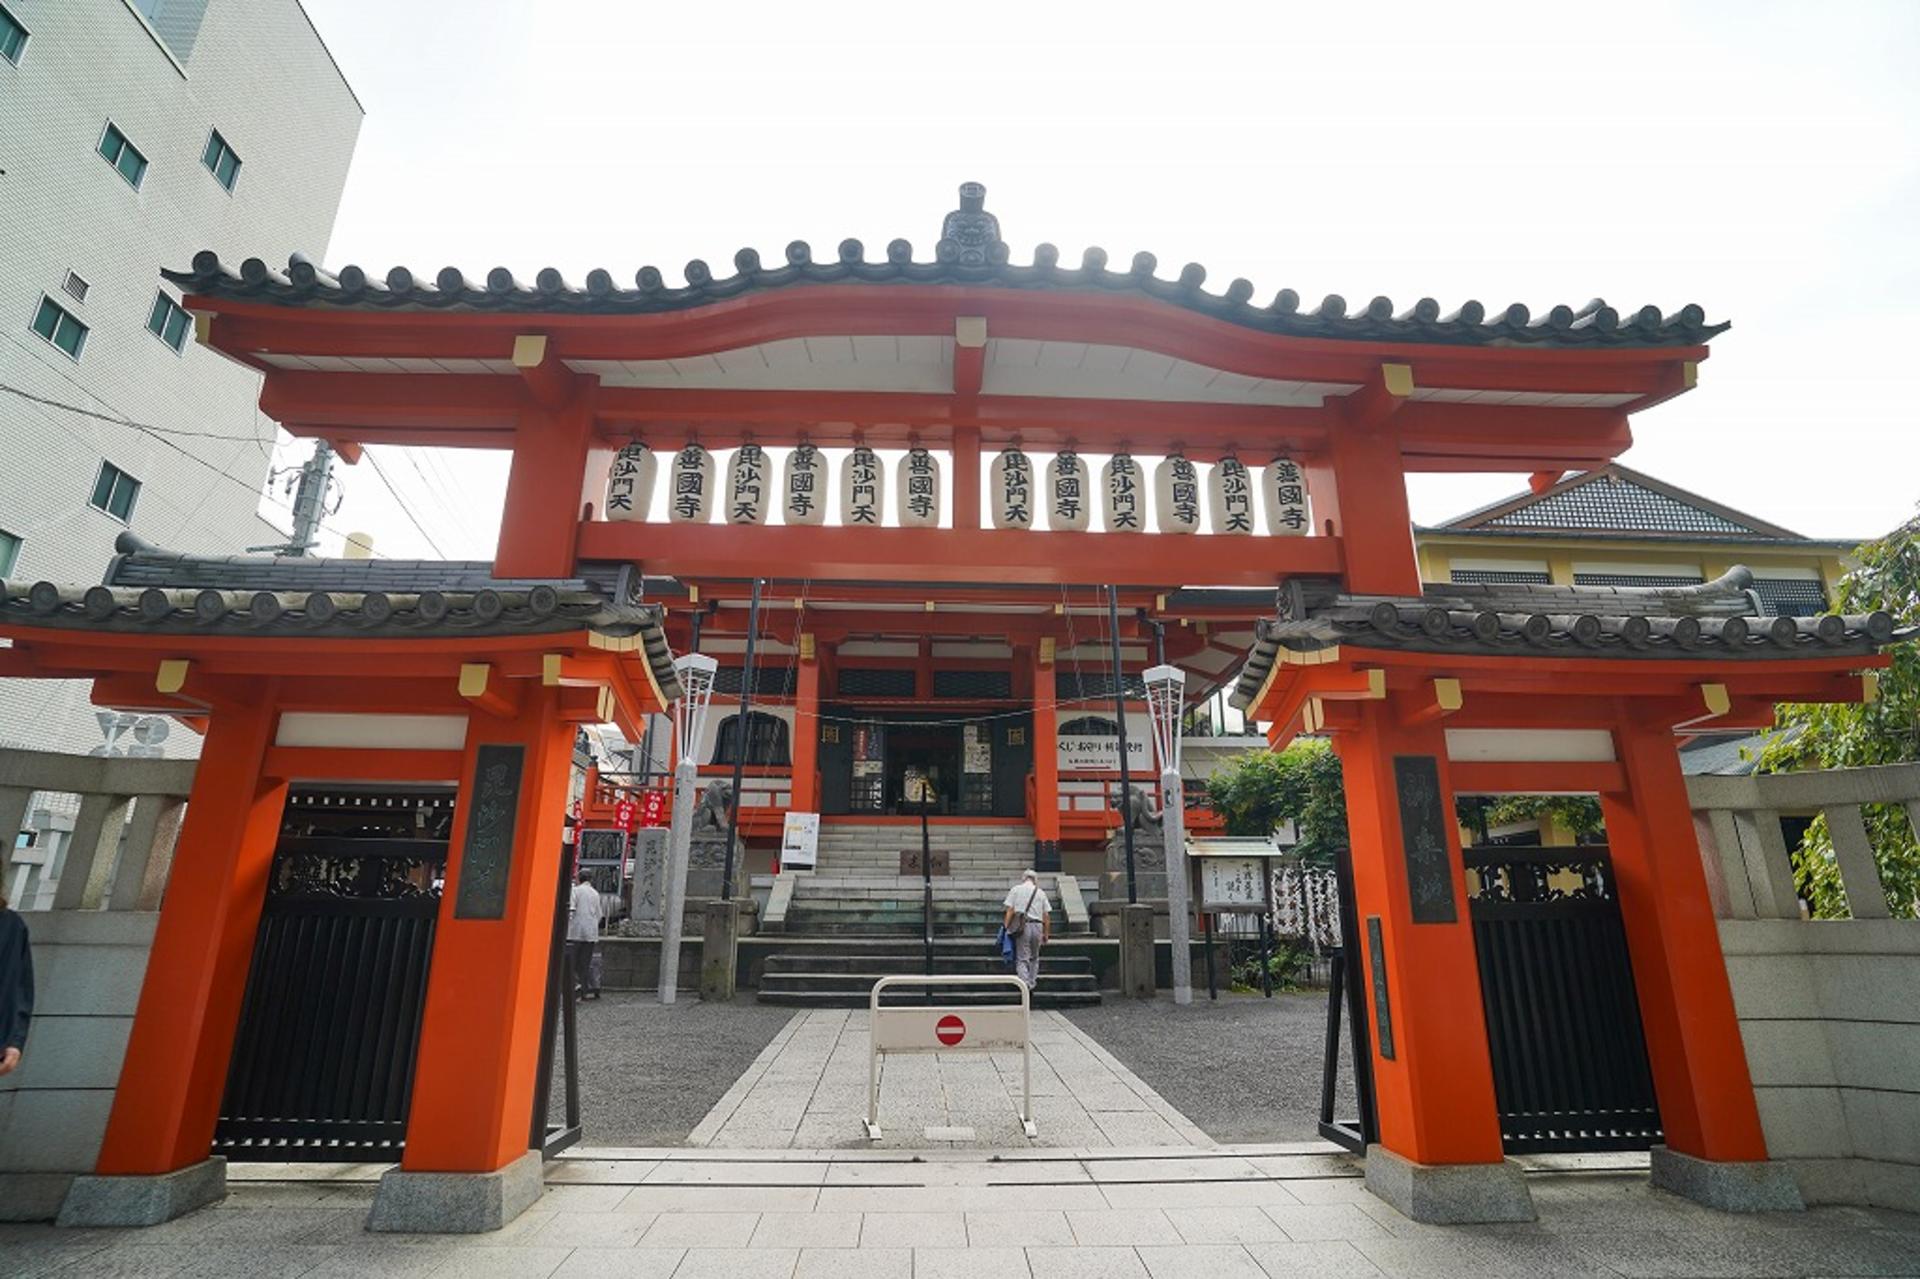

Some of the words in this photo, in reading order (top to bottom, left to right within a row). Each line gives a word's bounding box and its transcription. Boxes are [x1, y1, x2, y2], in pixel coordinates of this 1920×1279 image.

[675, 449, 705, 519] 善國寺
[733, 447, 762, 520] 毘沙門天
[789, 447, 818, 517] 善國寺
[850, 451, 876, 523] 毘沙門天
[907, 454, 935, 518] 善國寺
[1003, 453, 1028, 523] 毘沙門天
[1055, 456, 1082, 520] 善國寺
[1110, 458, 1137, 528] 毘沙門天
[1171, 459, 1199, 524] 善國寺
[1221, 459, 1250, 532] 毘沙門天
[1276, 462, 1307, 530] 善國寺
